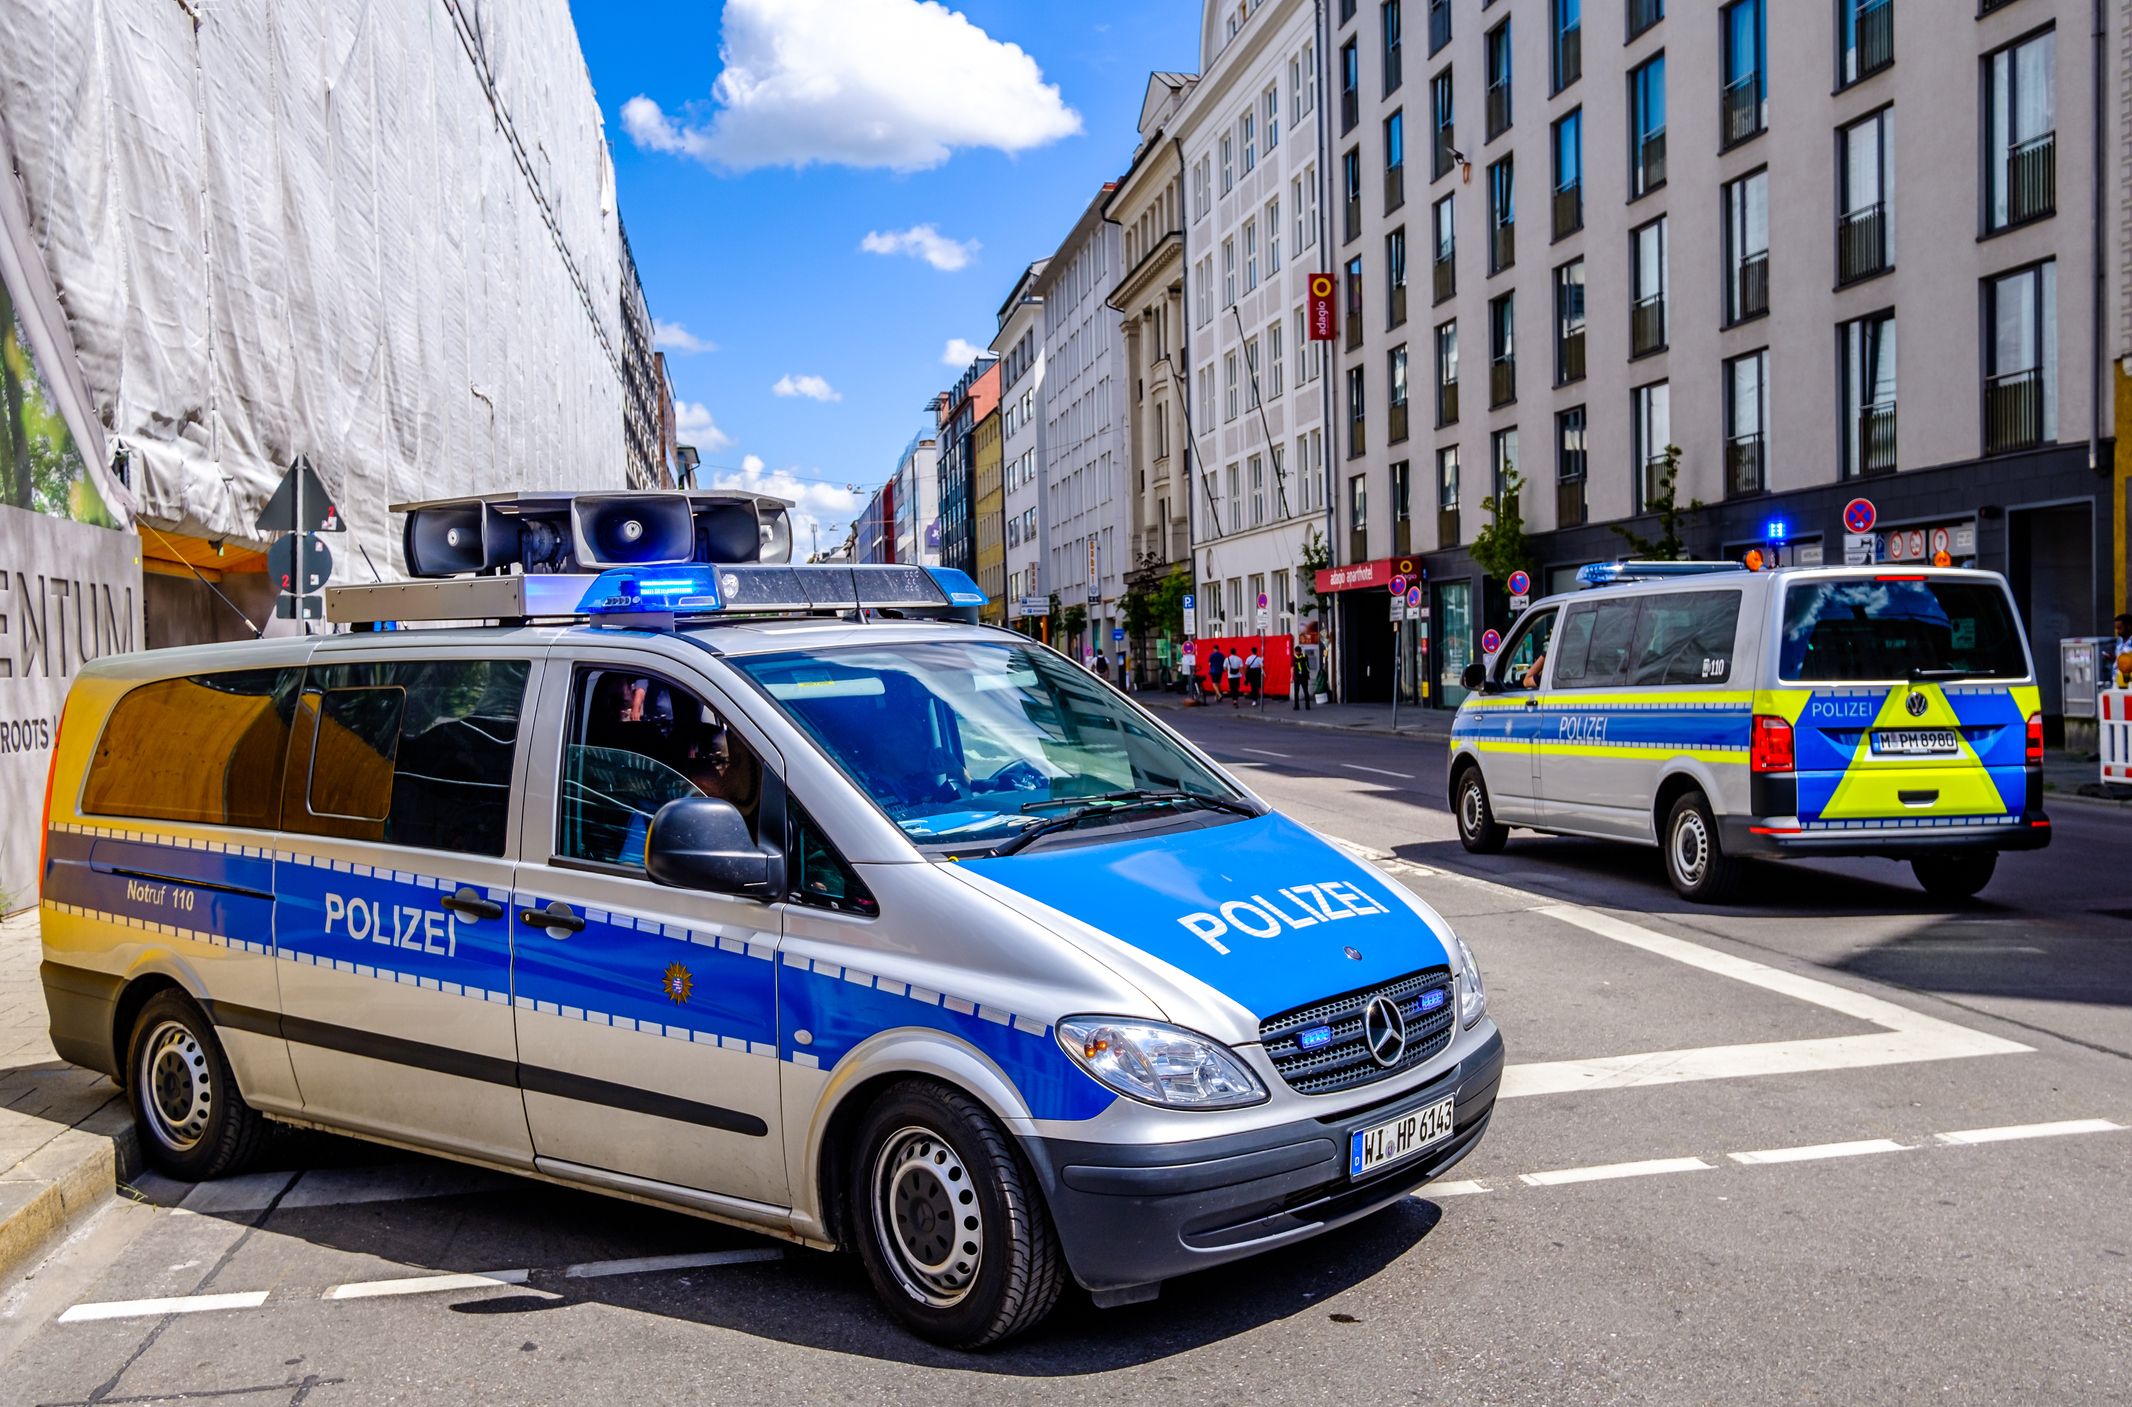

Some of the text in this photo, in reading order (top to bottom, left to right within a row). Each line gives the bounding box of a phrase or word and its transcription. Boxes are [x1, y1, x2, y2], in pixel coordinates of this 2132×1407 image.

[1316, 301, 1328, 335] adagio
[1330, 564, 1373, 589] adagio aparthotel
[1710, 658, 1725, 676] 110
[1812, 702, 1872, 717] POLIZEI
[0, 718, 49, 753] ROOTS
[1558, 716, 1608, 740] POLIZEI
[1880, 733, 1891, 749] M
[1899, 733, 1919, 748] PM
[1920, 732, 1954, 748] 8980
[126, 879, 195, 912] Notruf 110
[325, 892, 456, 957] POLIZEI
[1177, 881, 1390, 956] POLIZEI
[1364, 1100, 1453, 1166] WI HP 6143
